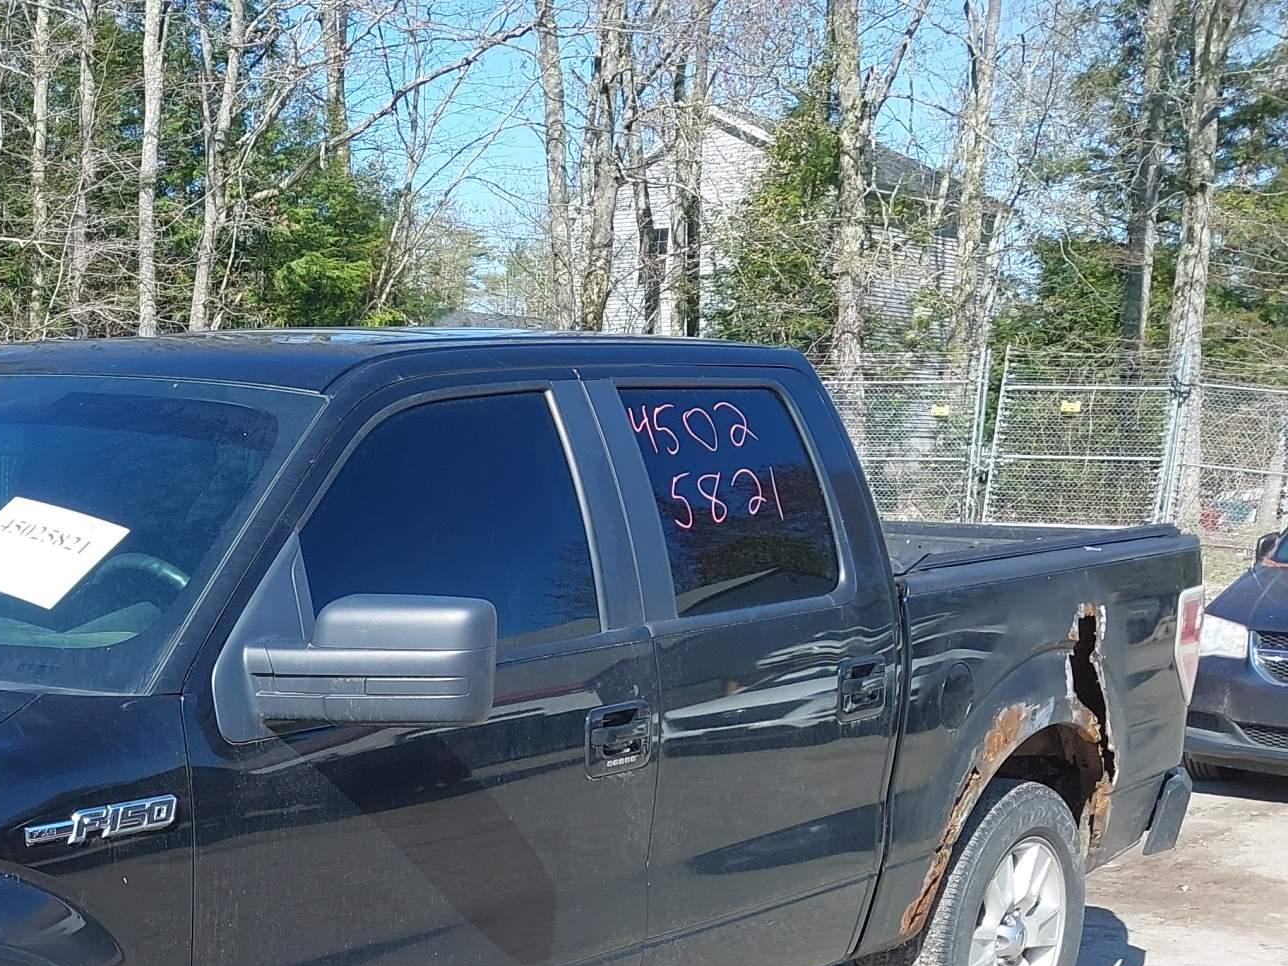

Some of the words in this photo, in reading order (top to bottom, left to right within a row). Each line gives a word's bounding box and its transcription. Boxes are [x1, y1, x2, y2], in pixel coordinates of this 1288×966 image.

[627, 401, 760, 455] 4502
[671, 465, 785, 529] 5821
[0, 519, 92, 555] 45025821
